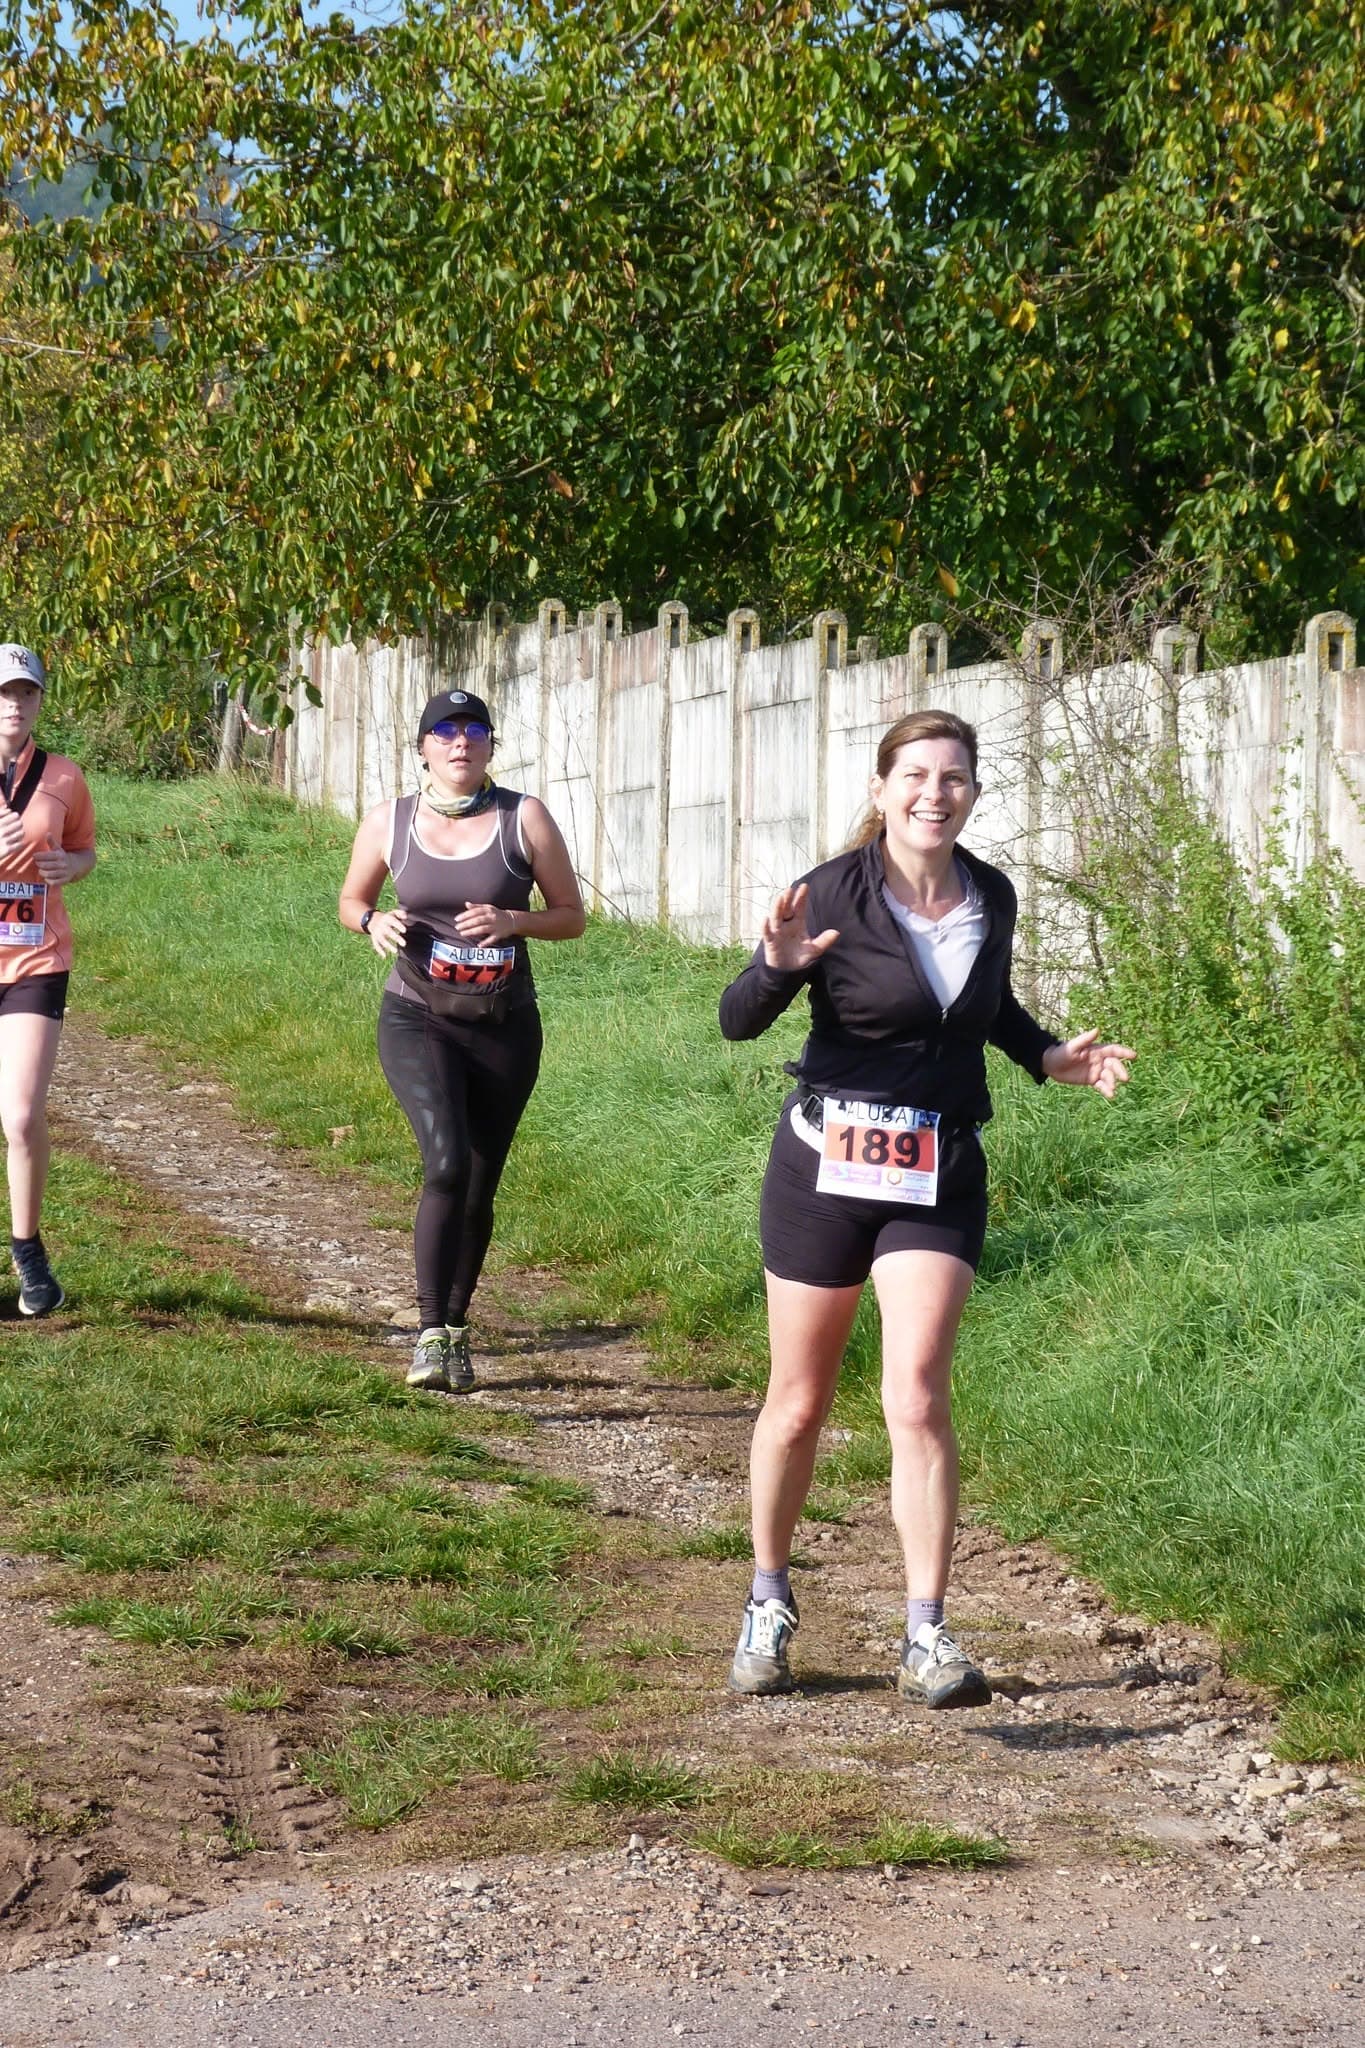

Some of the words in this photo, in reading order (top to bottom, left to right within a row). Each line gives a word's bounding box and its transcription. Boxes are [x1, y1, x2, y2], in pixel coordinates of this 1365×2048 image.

[0, 899, 34, 923] 76
[449, 948, 504, 961] ALUBAT
[443, 963, 504, 985] 177
[839, 1126, 920, 1169] 189
